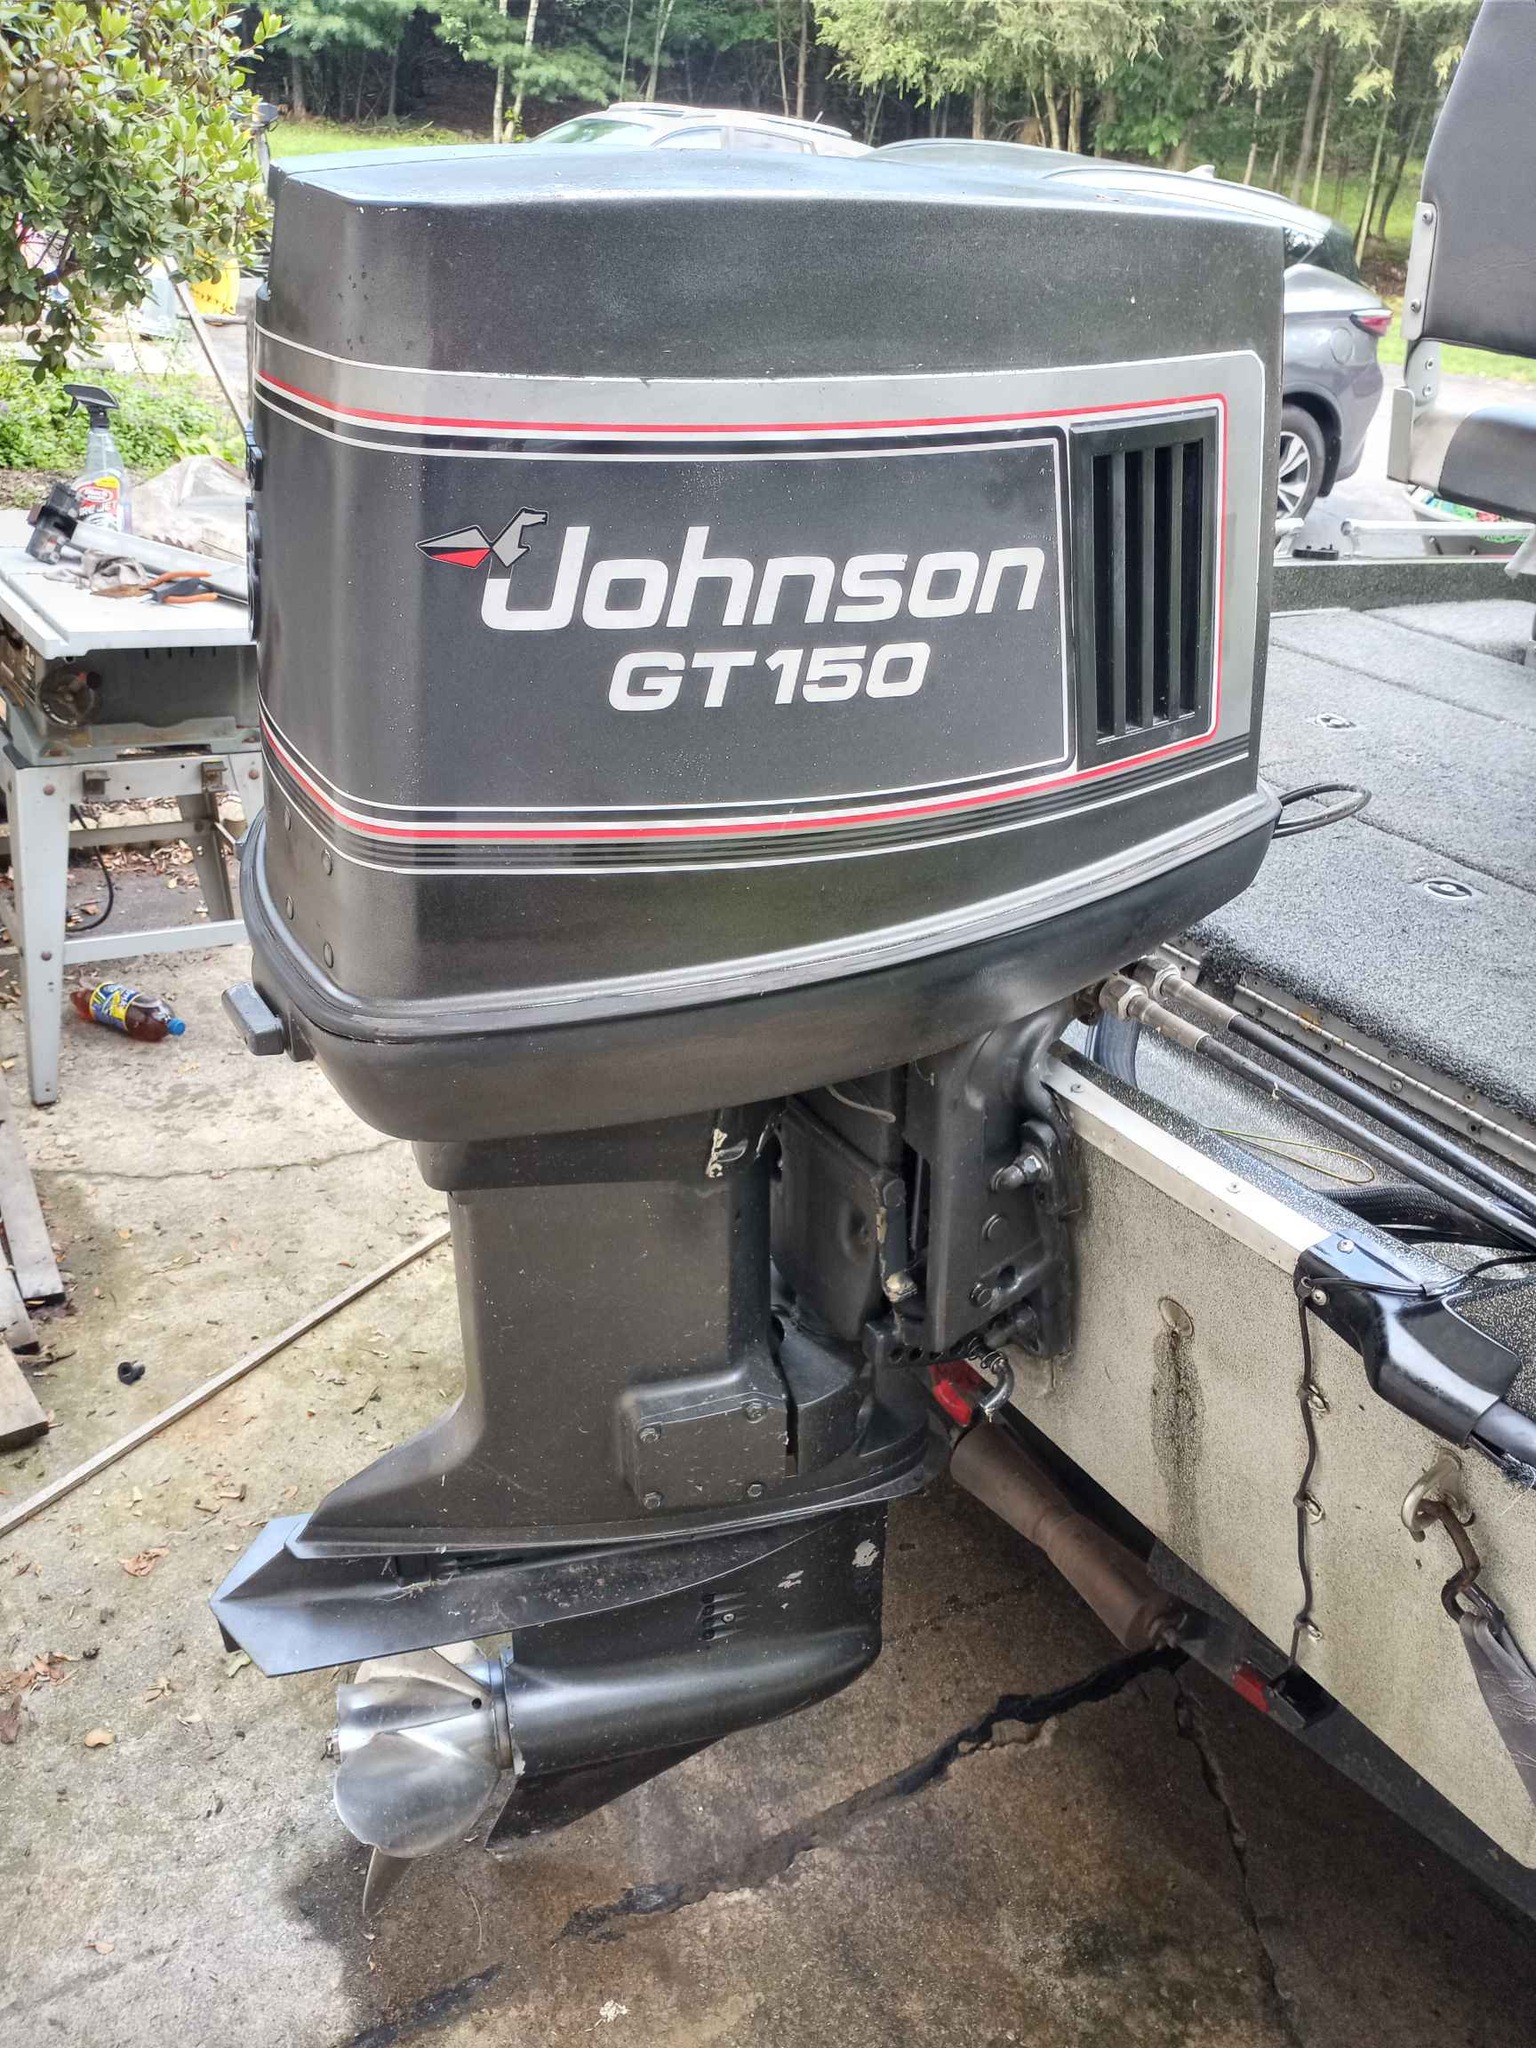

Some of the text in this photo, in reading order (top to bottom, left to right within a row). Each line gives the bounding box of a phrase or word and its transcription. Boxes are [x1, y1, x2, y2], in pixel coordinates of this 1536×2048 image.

[481, 525, 1045, 631] Johnson
[608, 641, 931, 712] GT 150
